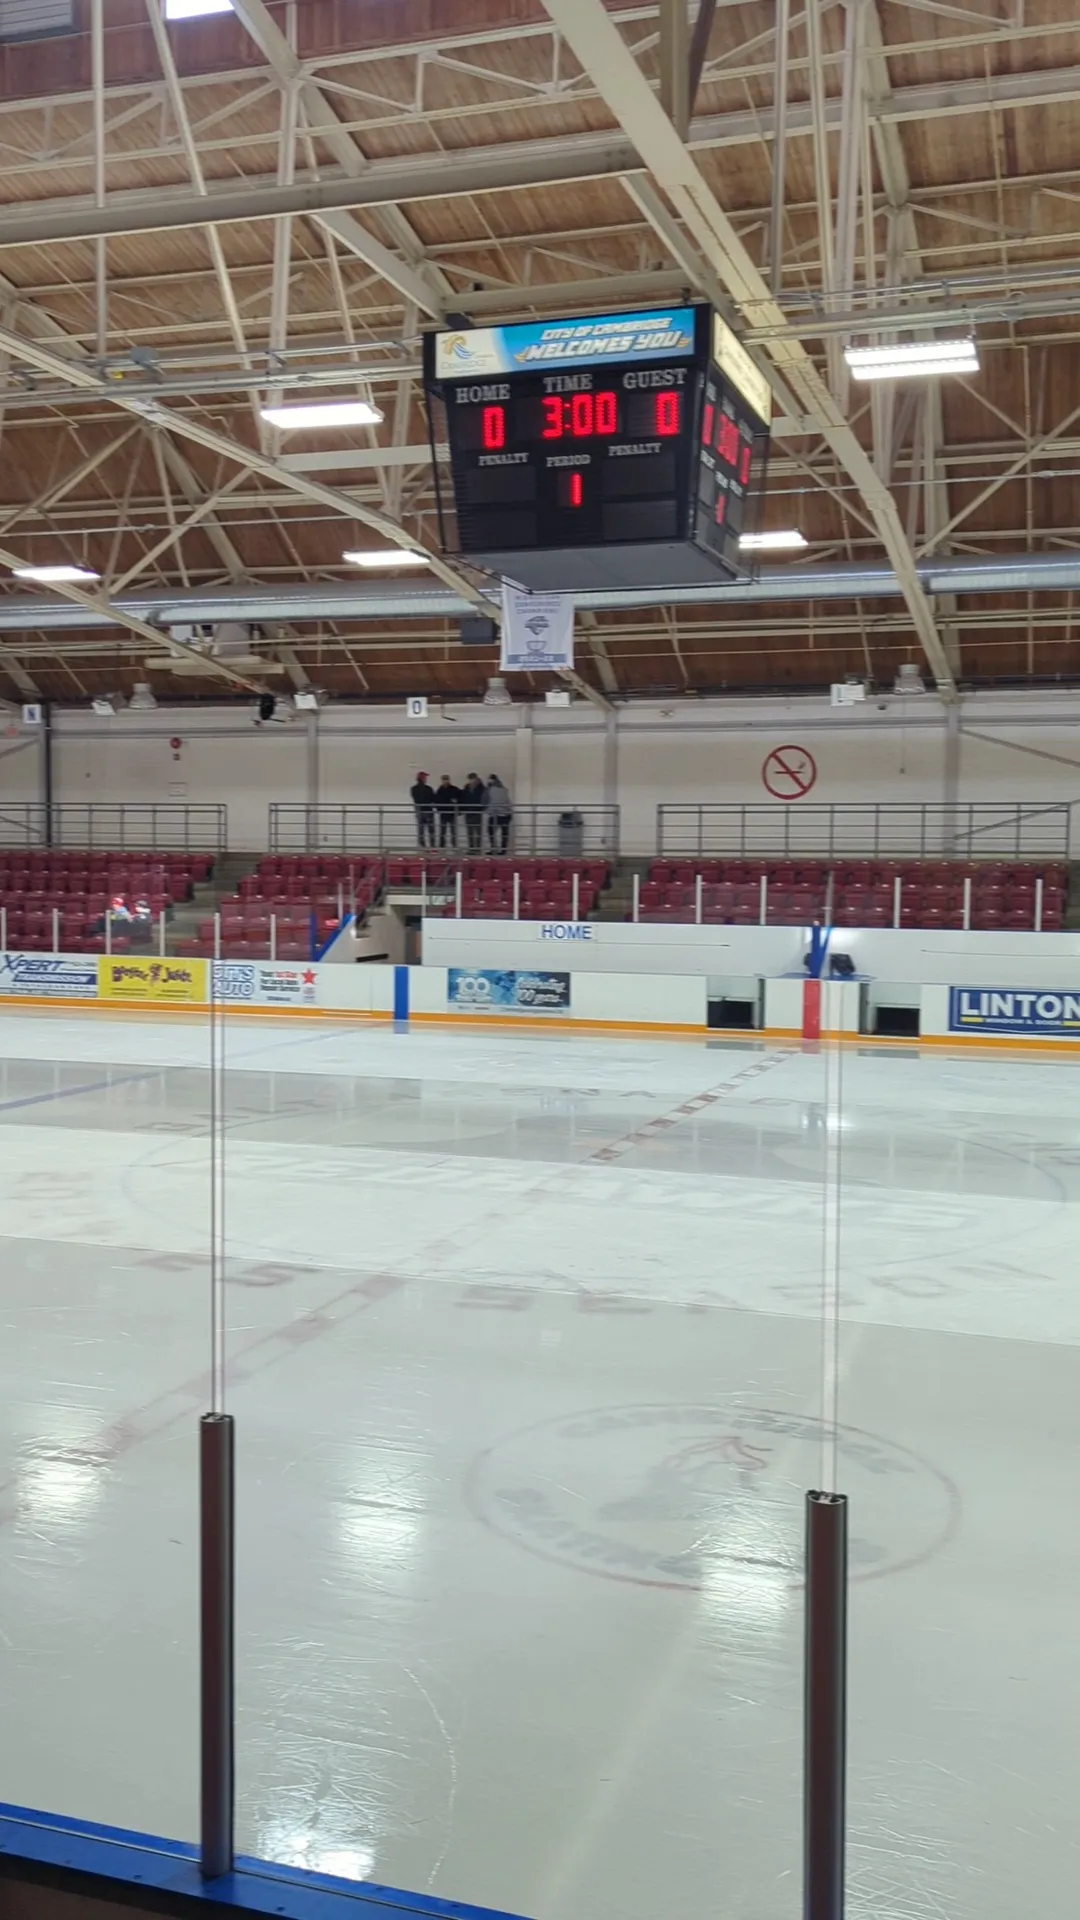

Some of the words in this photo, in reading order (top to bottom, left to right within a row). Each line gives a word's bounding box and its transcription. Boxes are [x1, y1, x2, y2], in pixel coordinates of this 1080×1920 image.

[540, 328, 575, 341] CITY
[573, 326, 593, 338] OF
[592, 318, 673, 336] CAMBRIDGE
[525, 335, 637, 362] WELCOMES
[632, 331, 683, 349] YOU
[543, 374, 593, 394] TIME
[623, 368, 688, 390] GUEST
[456, 384, 510, 403] HOME
[541, 392, 618, 439] 3:00
[655, 391, 680, 437] 0
[482, 406, 505, 449] 0
[478, 452, 529, 466] PENALTY
[608, 442, 662, 457] PENALTY
[546, 454, 591, 468] PERIOD
[570, 472, 582, 508] 1
[541, 924, 593, 940] HOME
[0, 954, 64, 974] XPERT
[212, 981, 255, 997] AUTO
[456, 977, 491, 995] 100
[960, 992, 1080, 1019] LINTON
